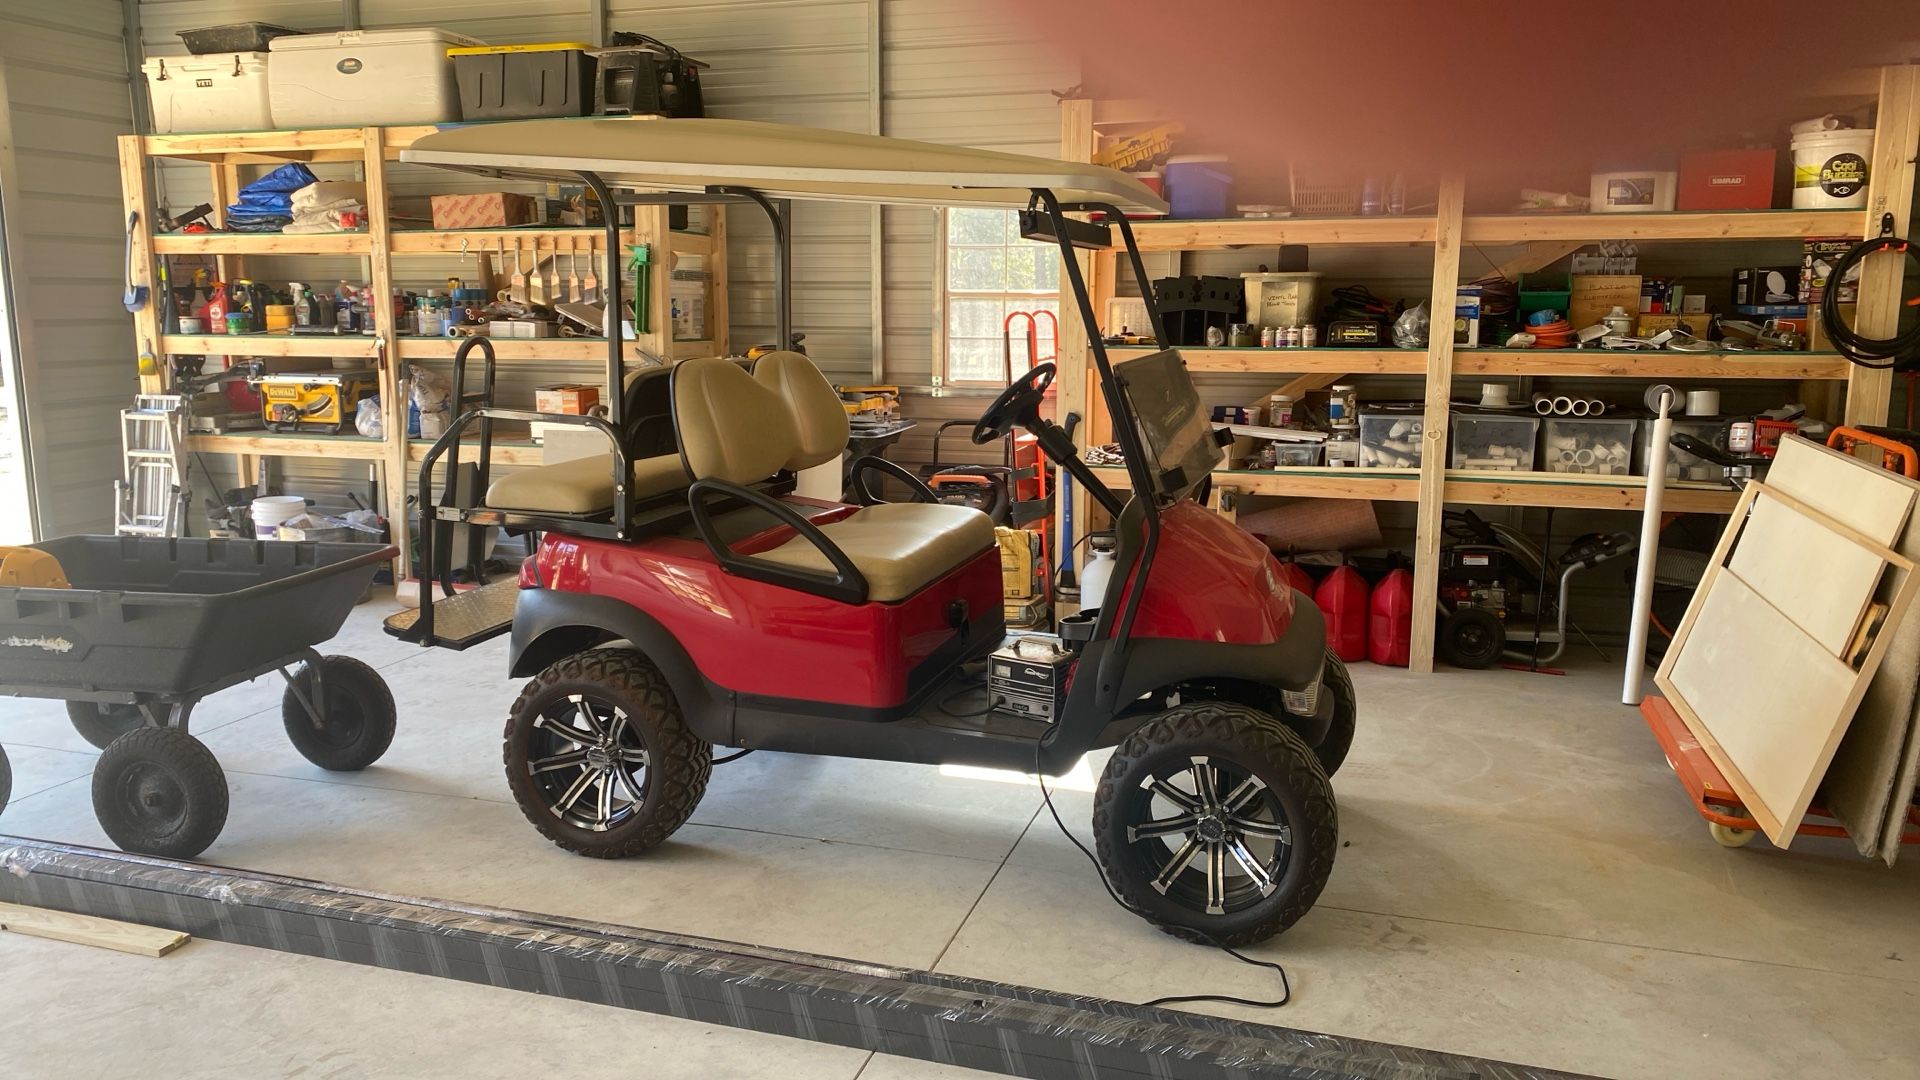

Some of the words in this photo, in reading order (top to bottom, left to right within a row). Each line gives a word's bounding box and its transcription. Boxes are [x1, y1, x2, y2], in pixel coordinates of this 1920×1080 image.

[1832, 160, 1857, 172] Cool
[1823, 169, 1864, 180] Bubbles
[1712, 177, 1742, 185] SIMRAD
[270, 387, 295, 397] DEWALT
